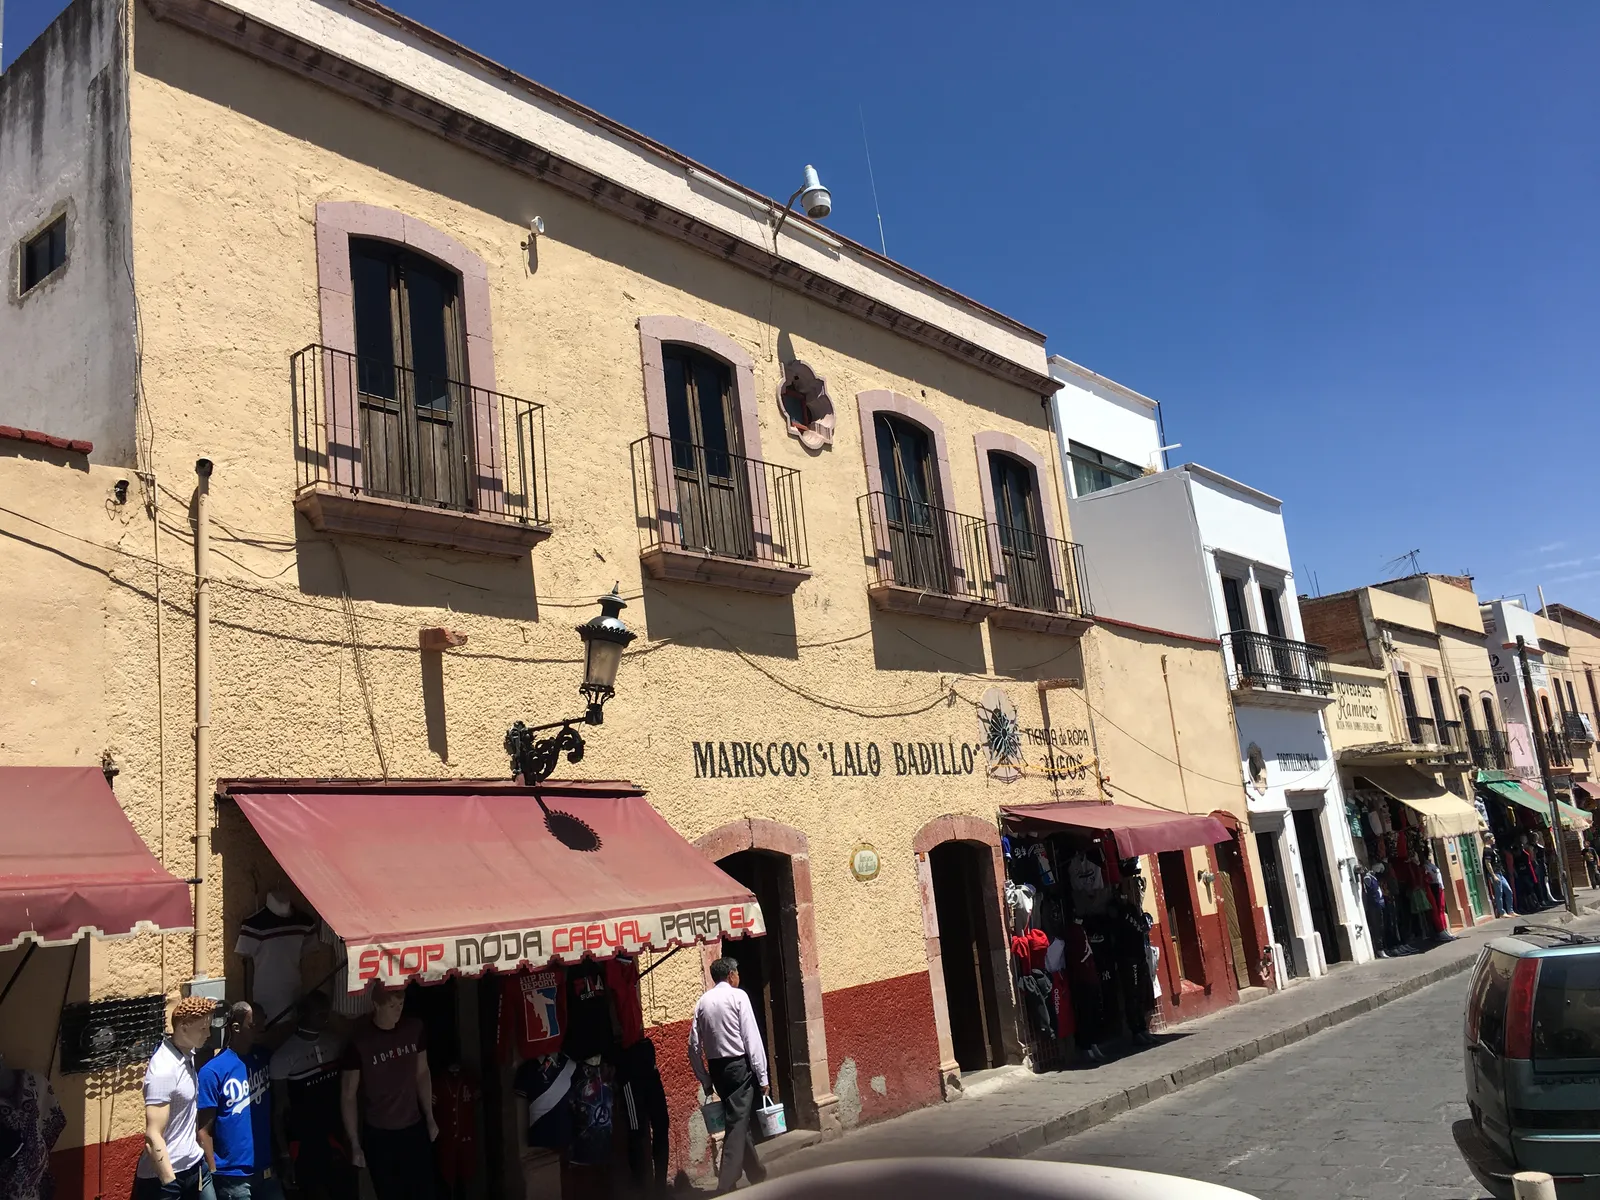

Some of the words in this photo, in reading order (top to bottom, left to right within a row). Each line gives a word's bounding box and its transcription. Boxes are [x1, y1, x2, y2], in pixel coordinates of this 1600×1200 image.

[1336, 682, 1372, 698] NOVEDADES
[1338, 695, 1379, 720] Ramirez
[1025, 728, 1058, 746] TIENDA
[1067, 729, 1090, 746] ROPA
[692, 741, 810, 779] MARISCOS
[358, 943, 445, 981] STOP
[455, 930, 543, 968] MODA
[551, 919, 652, 954] CASUAL
[660, 908, 722, 940] PARA
[729, 906, 755, 930] EL
